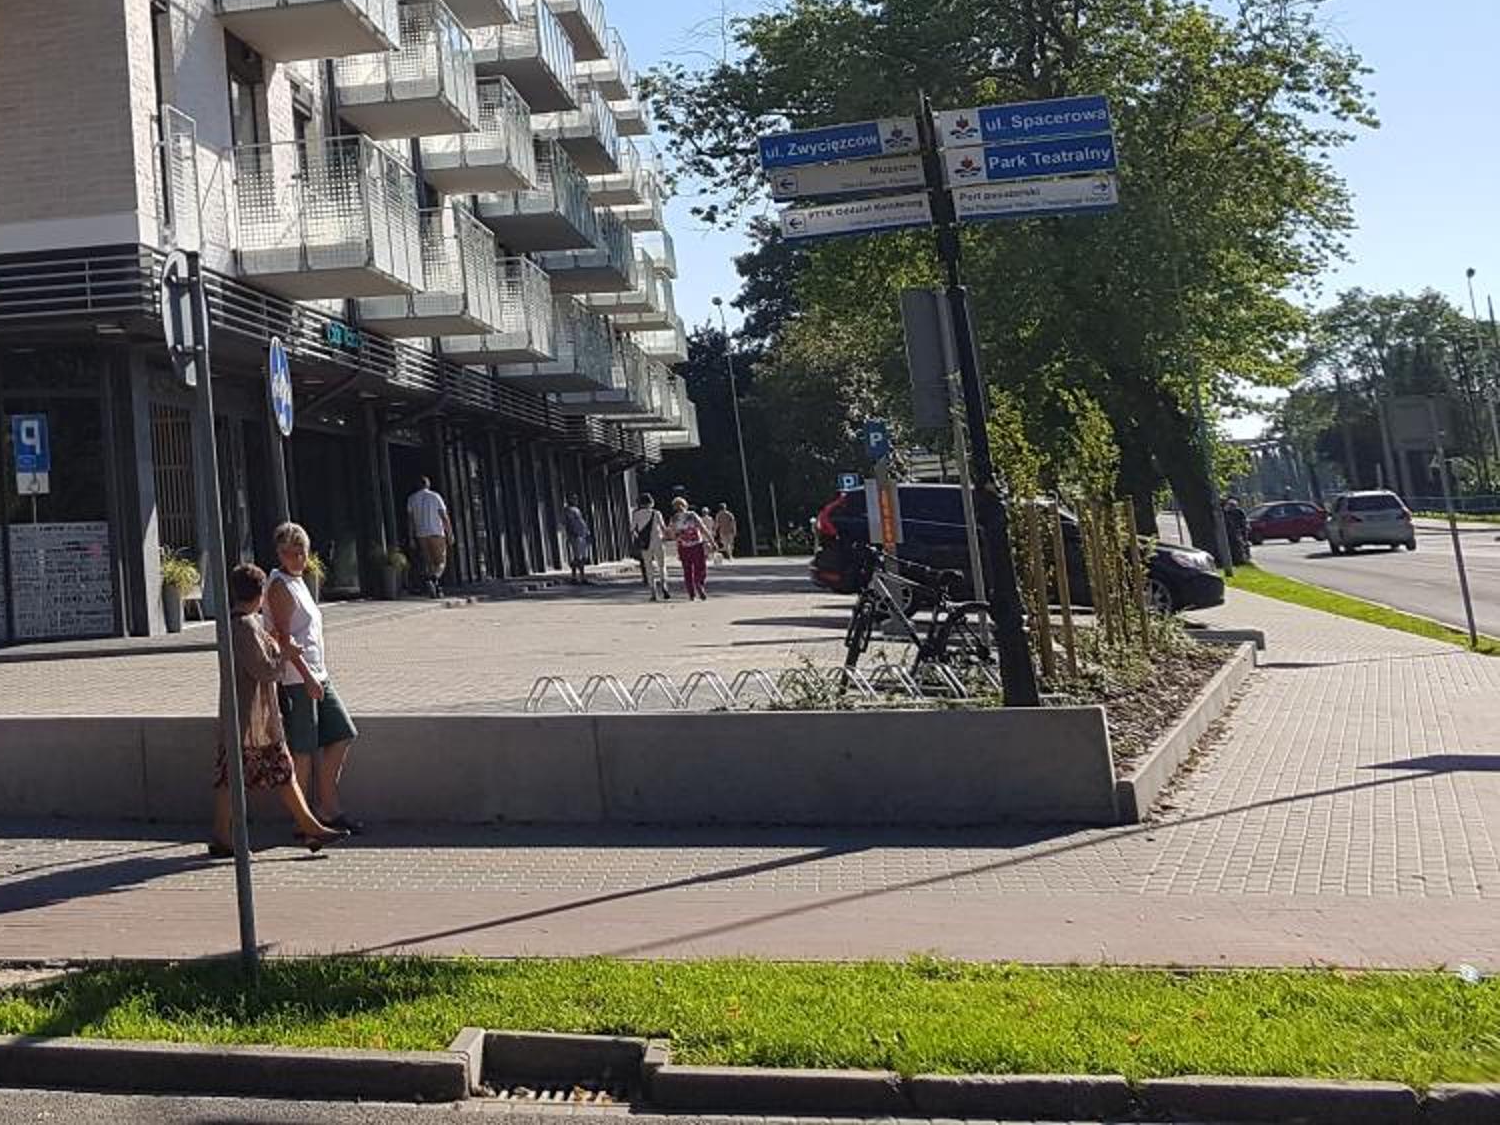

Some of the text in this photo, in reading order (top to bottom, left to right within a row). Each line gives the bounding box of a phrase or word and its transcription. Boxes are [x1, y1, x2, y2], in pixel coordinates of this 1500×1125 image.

[1011, 108, 1107, 131] Spacerowa
[765, 146, 784, 158] ul.
[988, 145, 1112, 170] Park Teatralny
[869, 431, 883, 446] P
